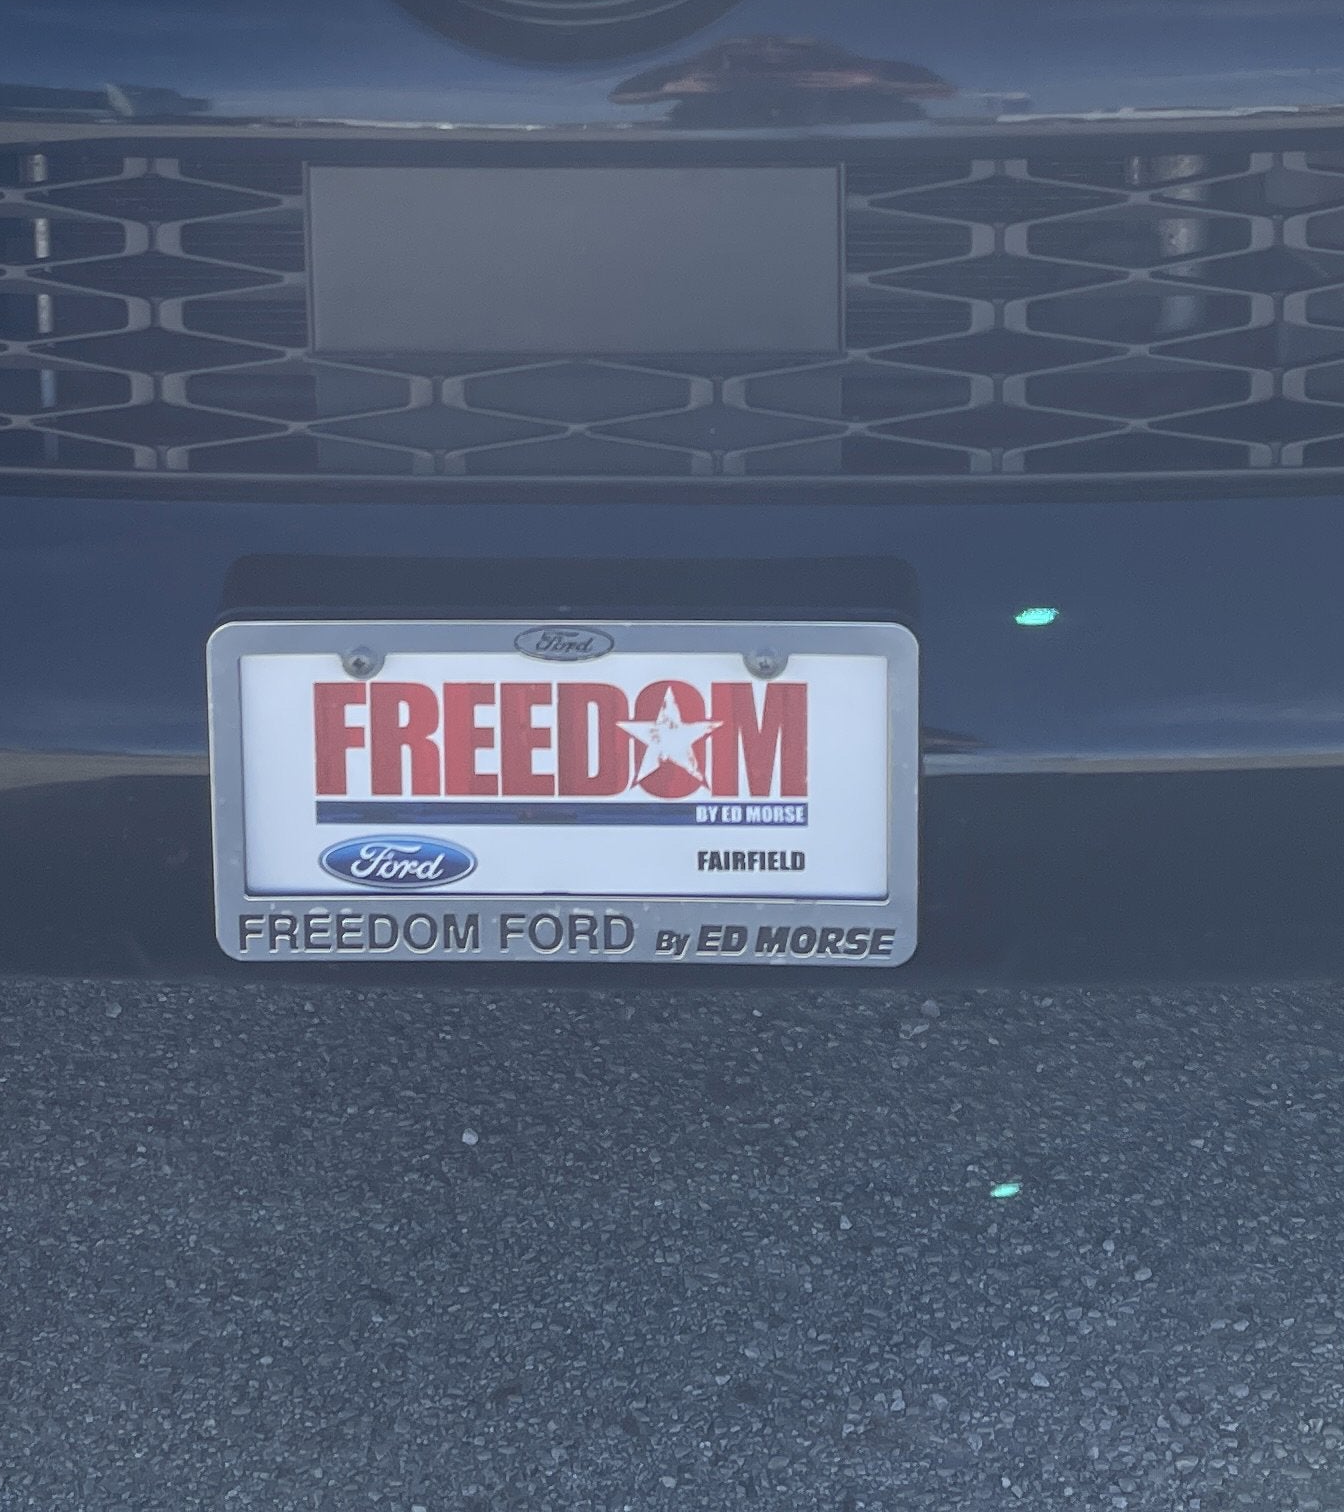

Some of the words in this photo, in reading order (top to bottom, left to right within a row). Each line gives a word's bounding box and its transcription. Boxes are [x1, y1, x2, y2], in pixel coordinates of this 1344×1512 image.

[535, 630, 595, 653] Ford
[313, 680, 809, 798] FREEDOM
[696, 805, 718, 824] BY
[721, 805, 743, 824] ED
[745, 805, 805, 824] MORSE
[350, 842, 445, 883] Ford
[697, 850, 806, 871] FAIRFIELD
[238, 913, 481, 954] FREEDOM
[499, 913, 636, 955] FORD
[655, 929, 691, 960] By
[696, 924, 749, 957] ED
[755, 926, 897, 959] MORSE
